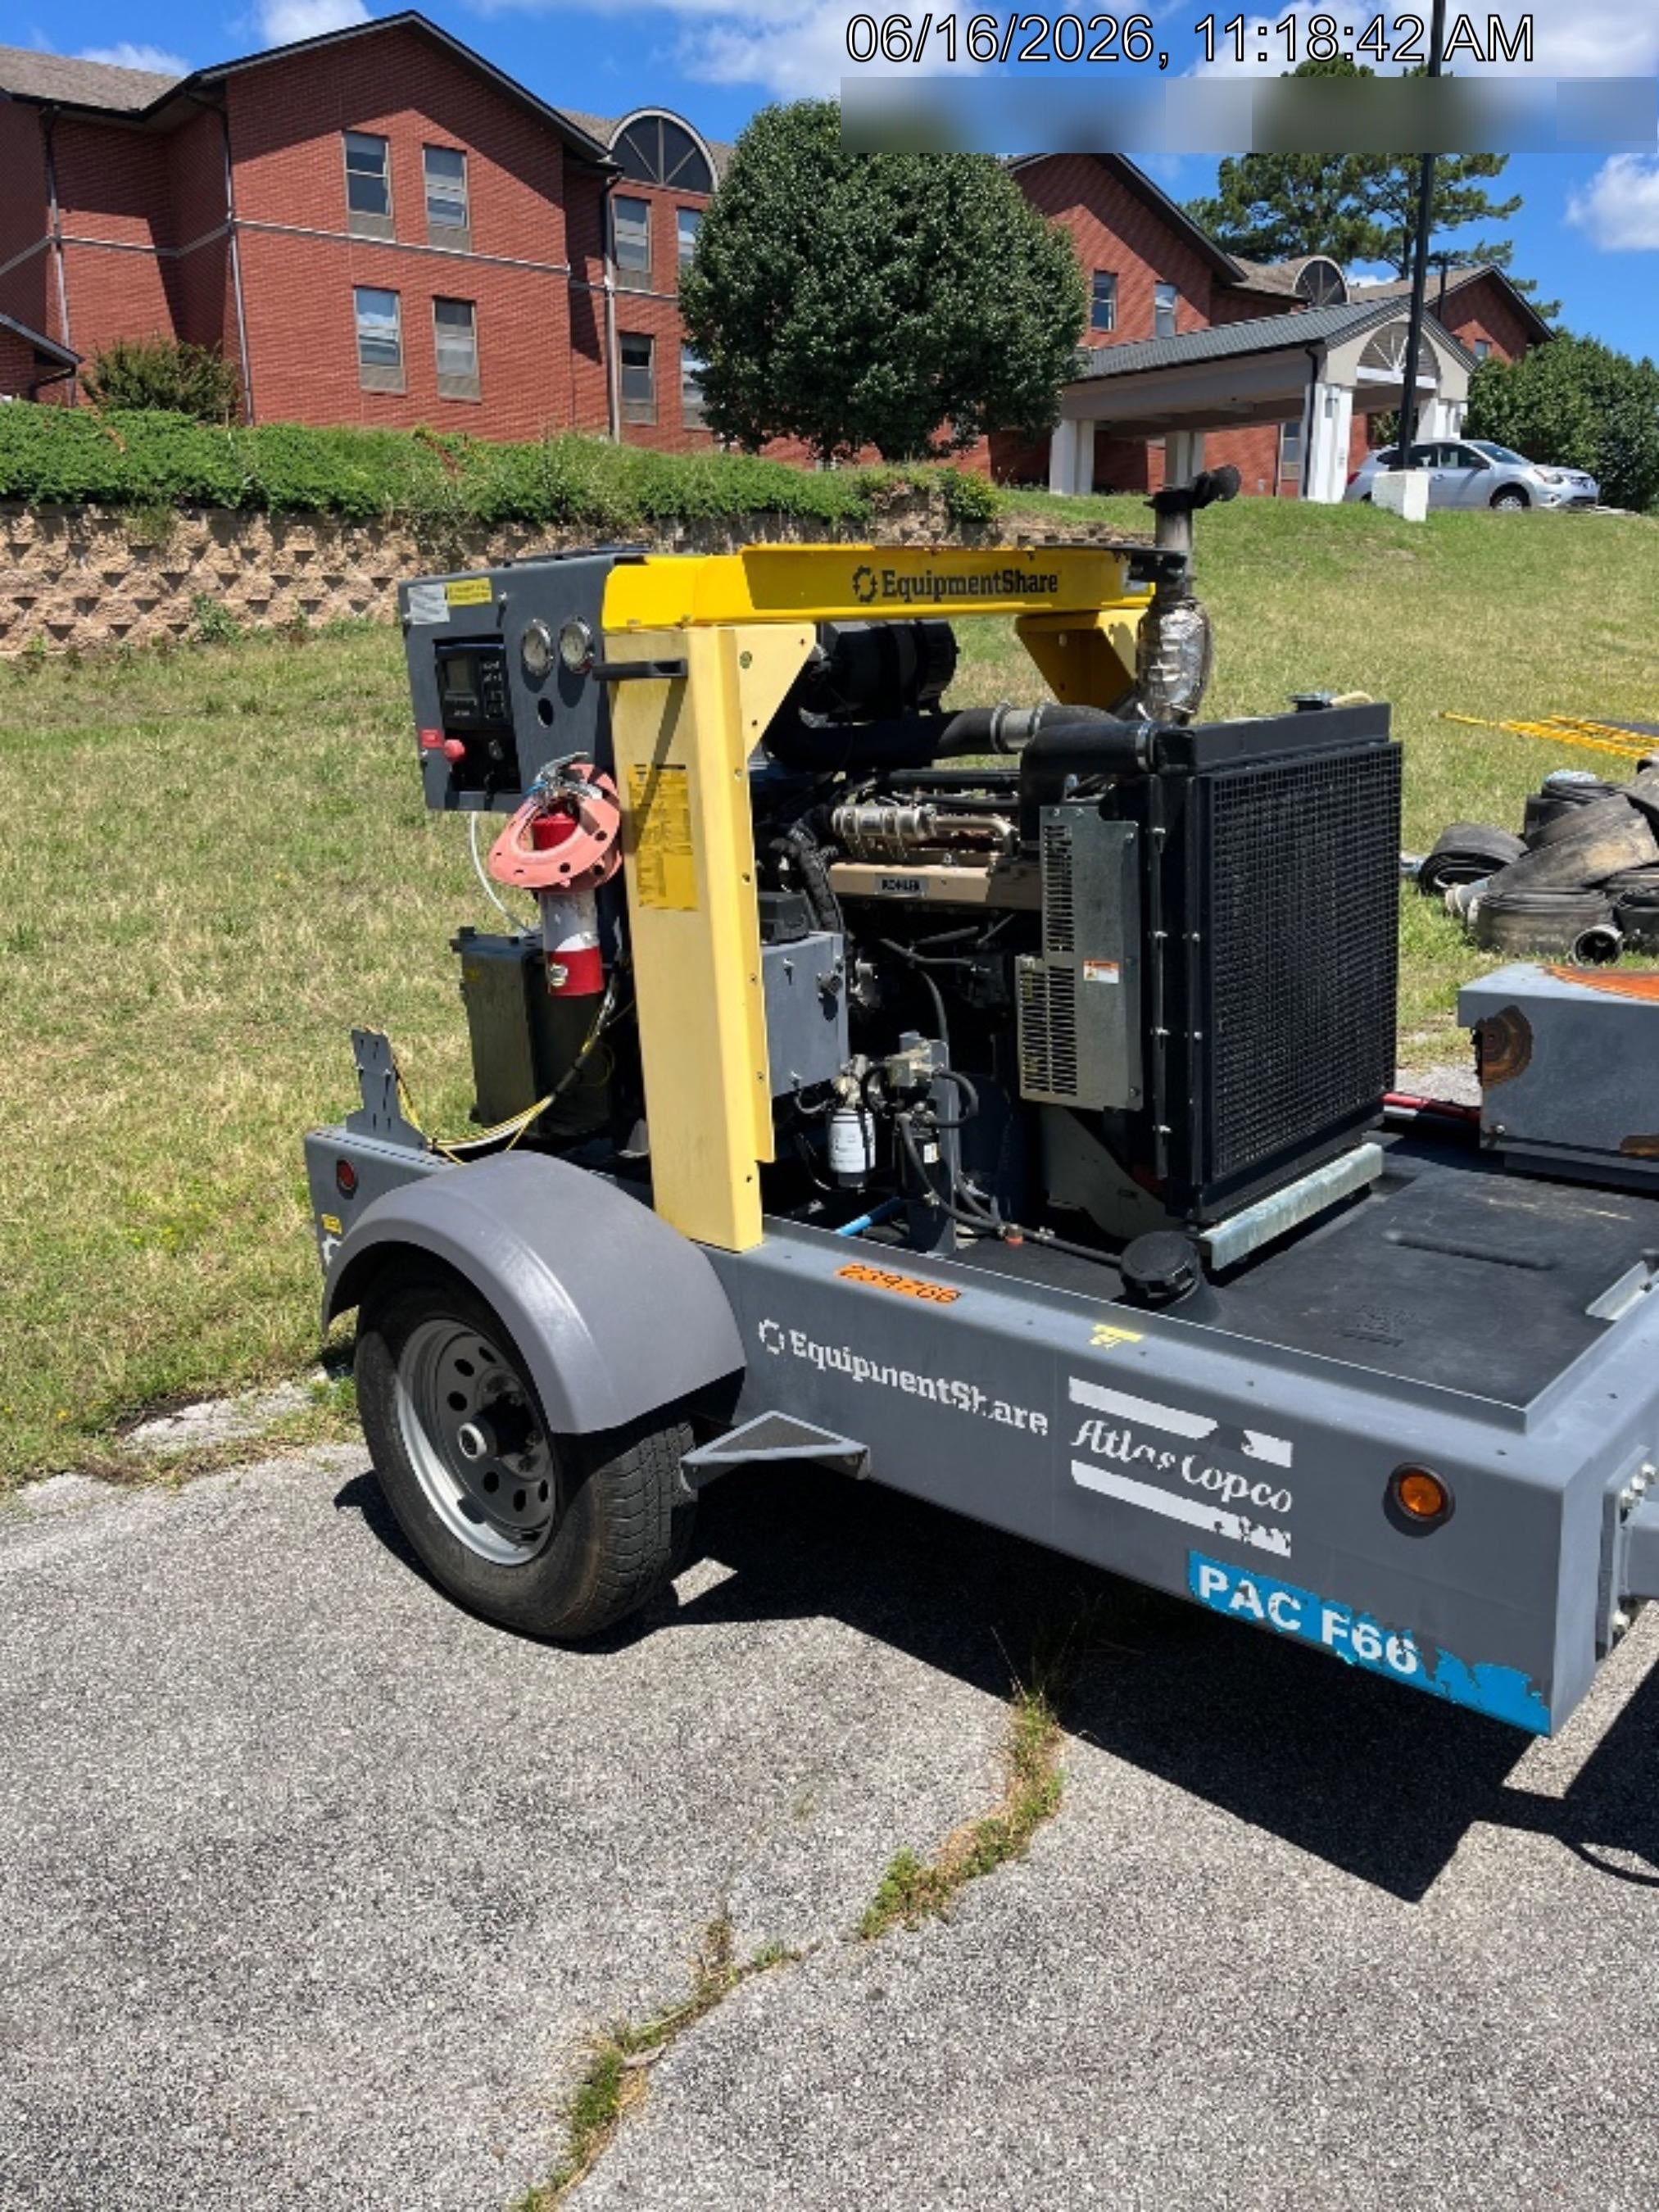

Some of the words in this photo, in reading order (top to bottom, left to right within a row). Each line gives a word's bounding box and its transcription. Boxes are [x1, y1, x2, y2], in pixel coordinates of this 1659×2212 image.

[882, 569, 1058, 602] EquipmentShare
[1181, 1454, 1292, 1512] Copco
[1199, 1563, 1302, 1632] PAC
[1321, 1607, 1419, 1676] F66
